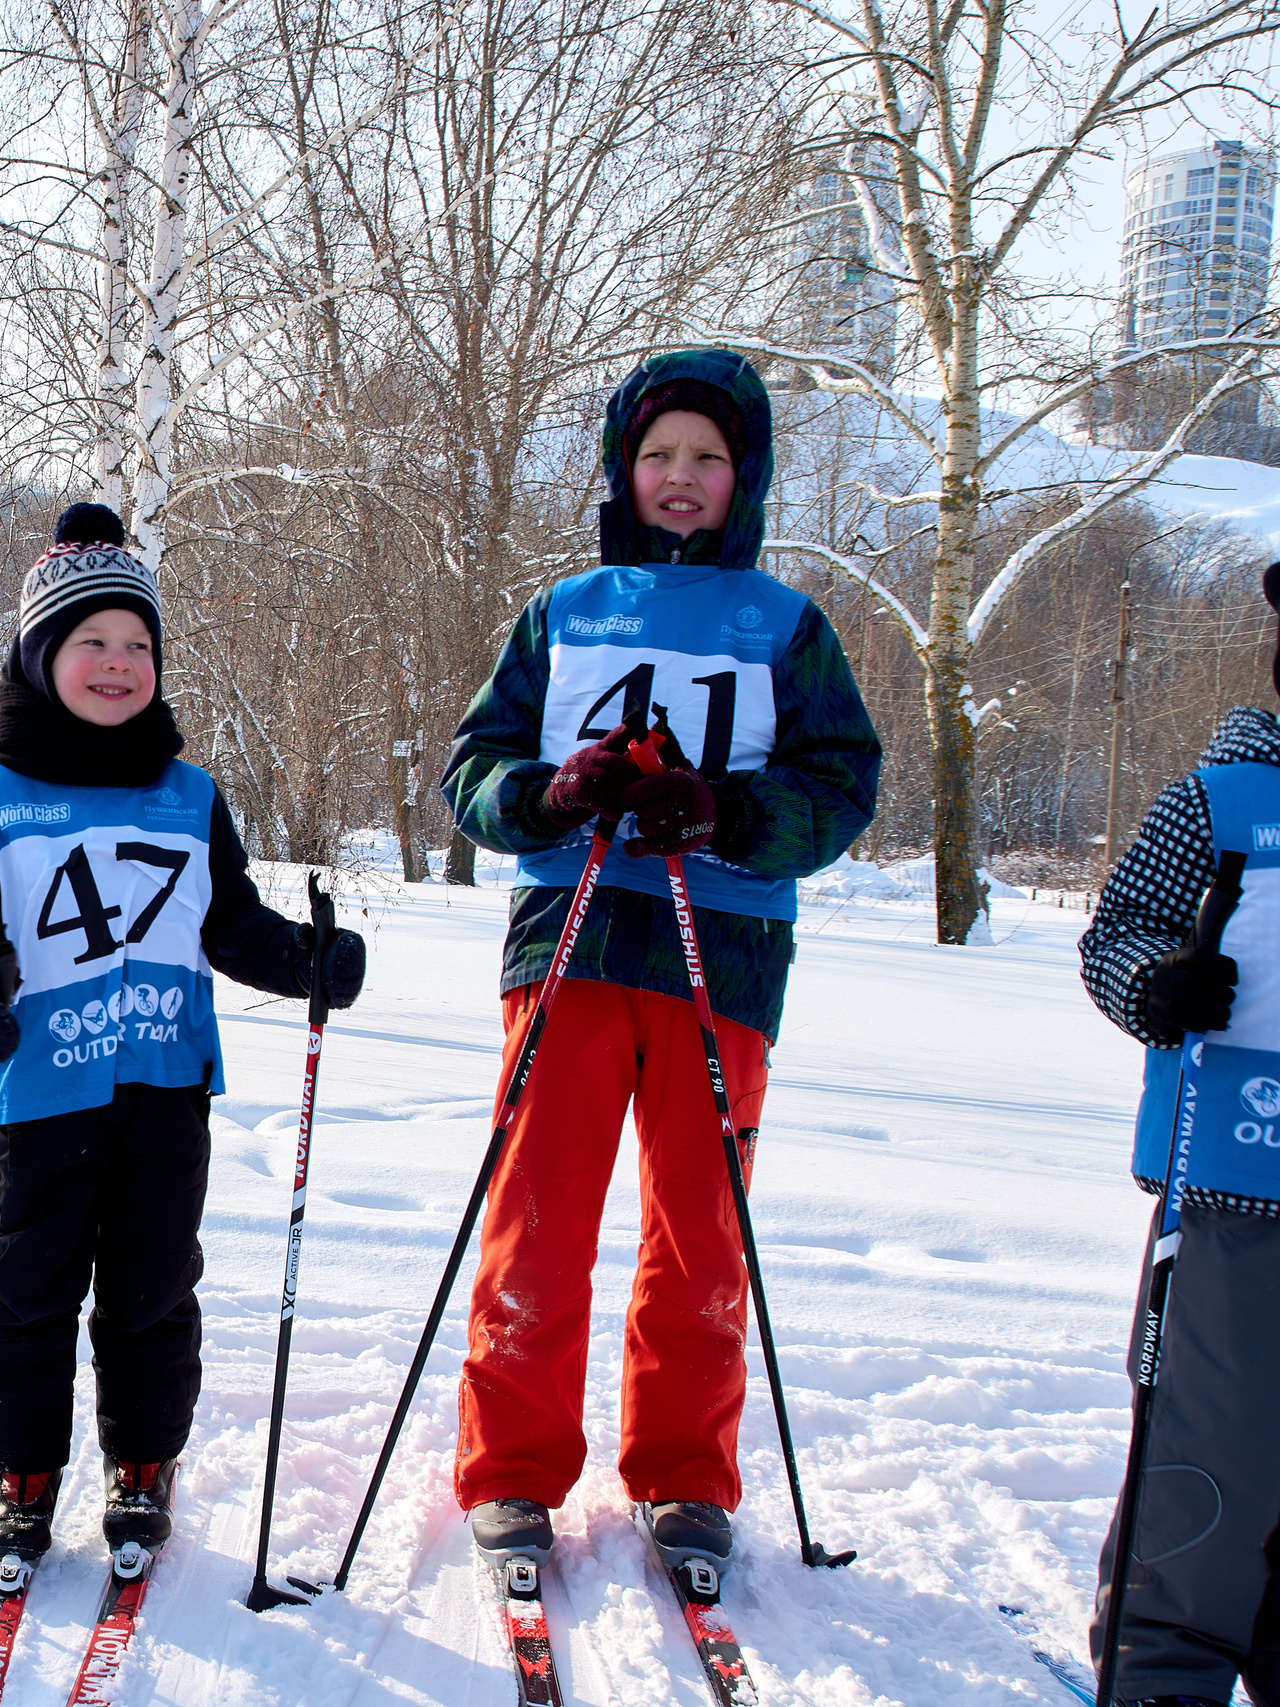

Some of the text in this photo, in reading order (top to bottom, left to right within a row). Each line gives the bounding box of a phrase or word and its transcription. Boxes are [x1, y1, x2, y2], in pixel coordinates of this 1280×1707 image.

[576, 662, 737, 773] 41
[34, 804, 69, 822] Class
[36, 841, 191, 965] 47
[556, 863, 601, 978] MADSHUS
[668, 875, 704, 988] MADSHUS
[707, 1058, 725, 1093] CT 90
[294, 1072, 313, 1178] NORDWAY
[282, 1227, 303, 1311] XC ACTIVE JR
[1138, 1309, 1160, 1386] NORDWAY
[73, 1626, 129, 1707] NORDWA
